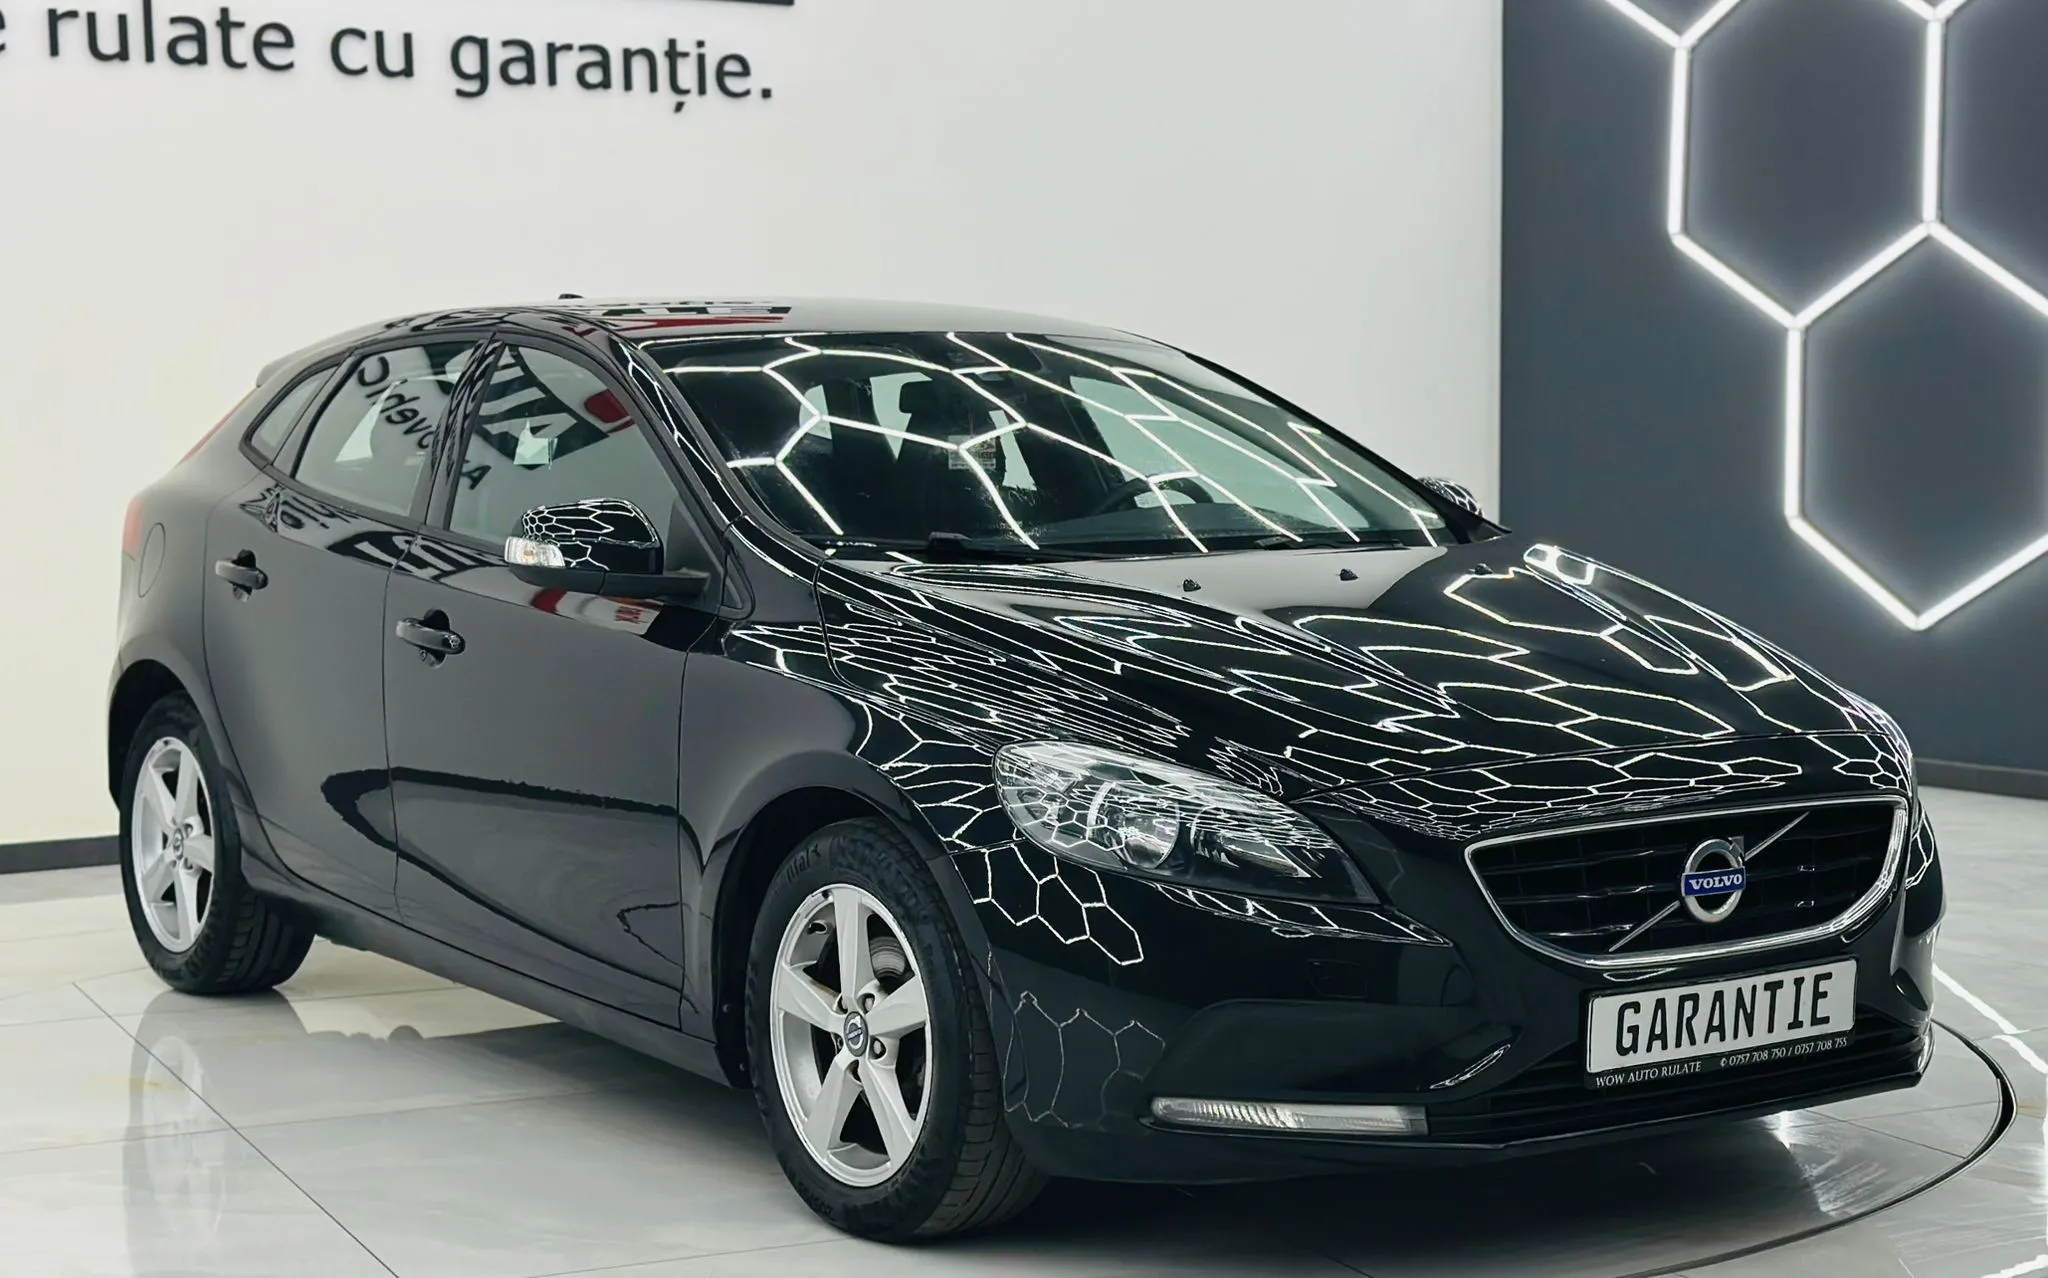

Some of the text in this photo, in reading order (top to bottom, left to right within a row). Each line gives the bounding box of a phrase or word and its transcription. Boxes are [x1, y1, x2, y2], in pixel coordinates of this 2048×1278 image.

[48, 0, 295, 71] rulate
[330, 26, 415, 79] cu
[450, 35, 773, 113] garanție.
[1688, 873, 1743, 890] VOLVO
[1615, 971, 1834, 1057] GARANTIE
[1728, 1053, 1750, 1067] 0757
[1752, 1049, 1769, 1063] 708
[1771, 1046, 1786, 1060] 750
[1794, 1042, 1815, 1056] 0757
[1816, 1039, 1833, 1052] 708
[1595, 1061, 1702, 1088] WOW AUTO RULATE
